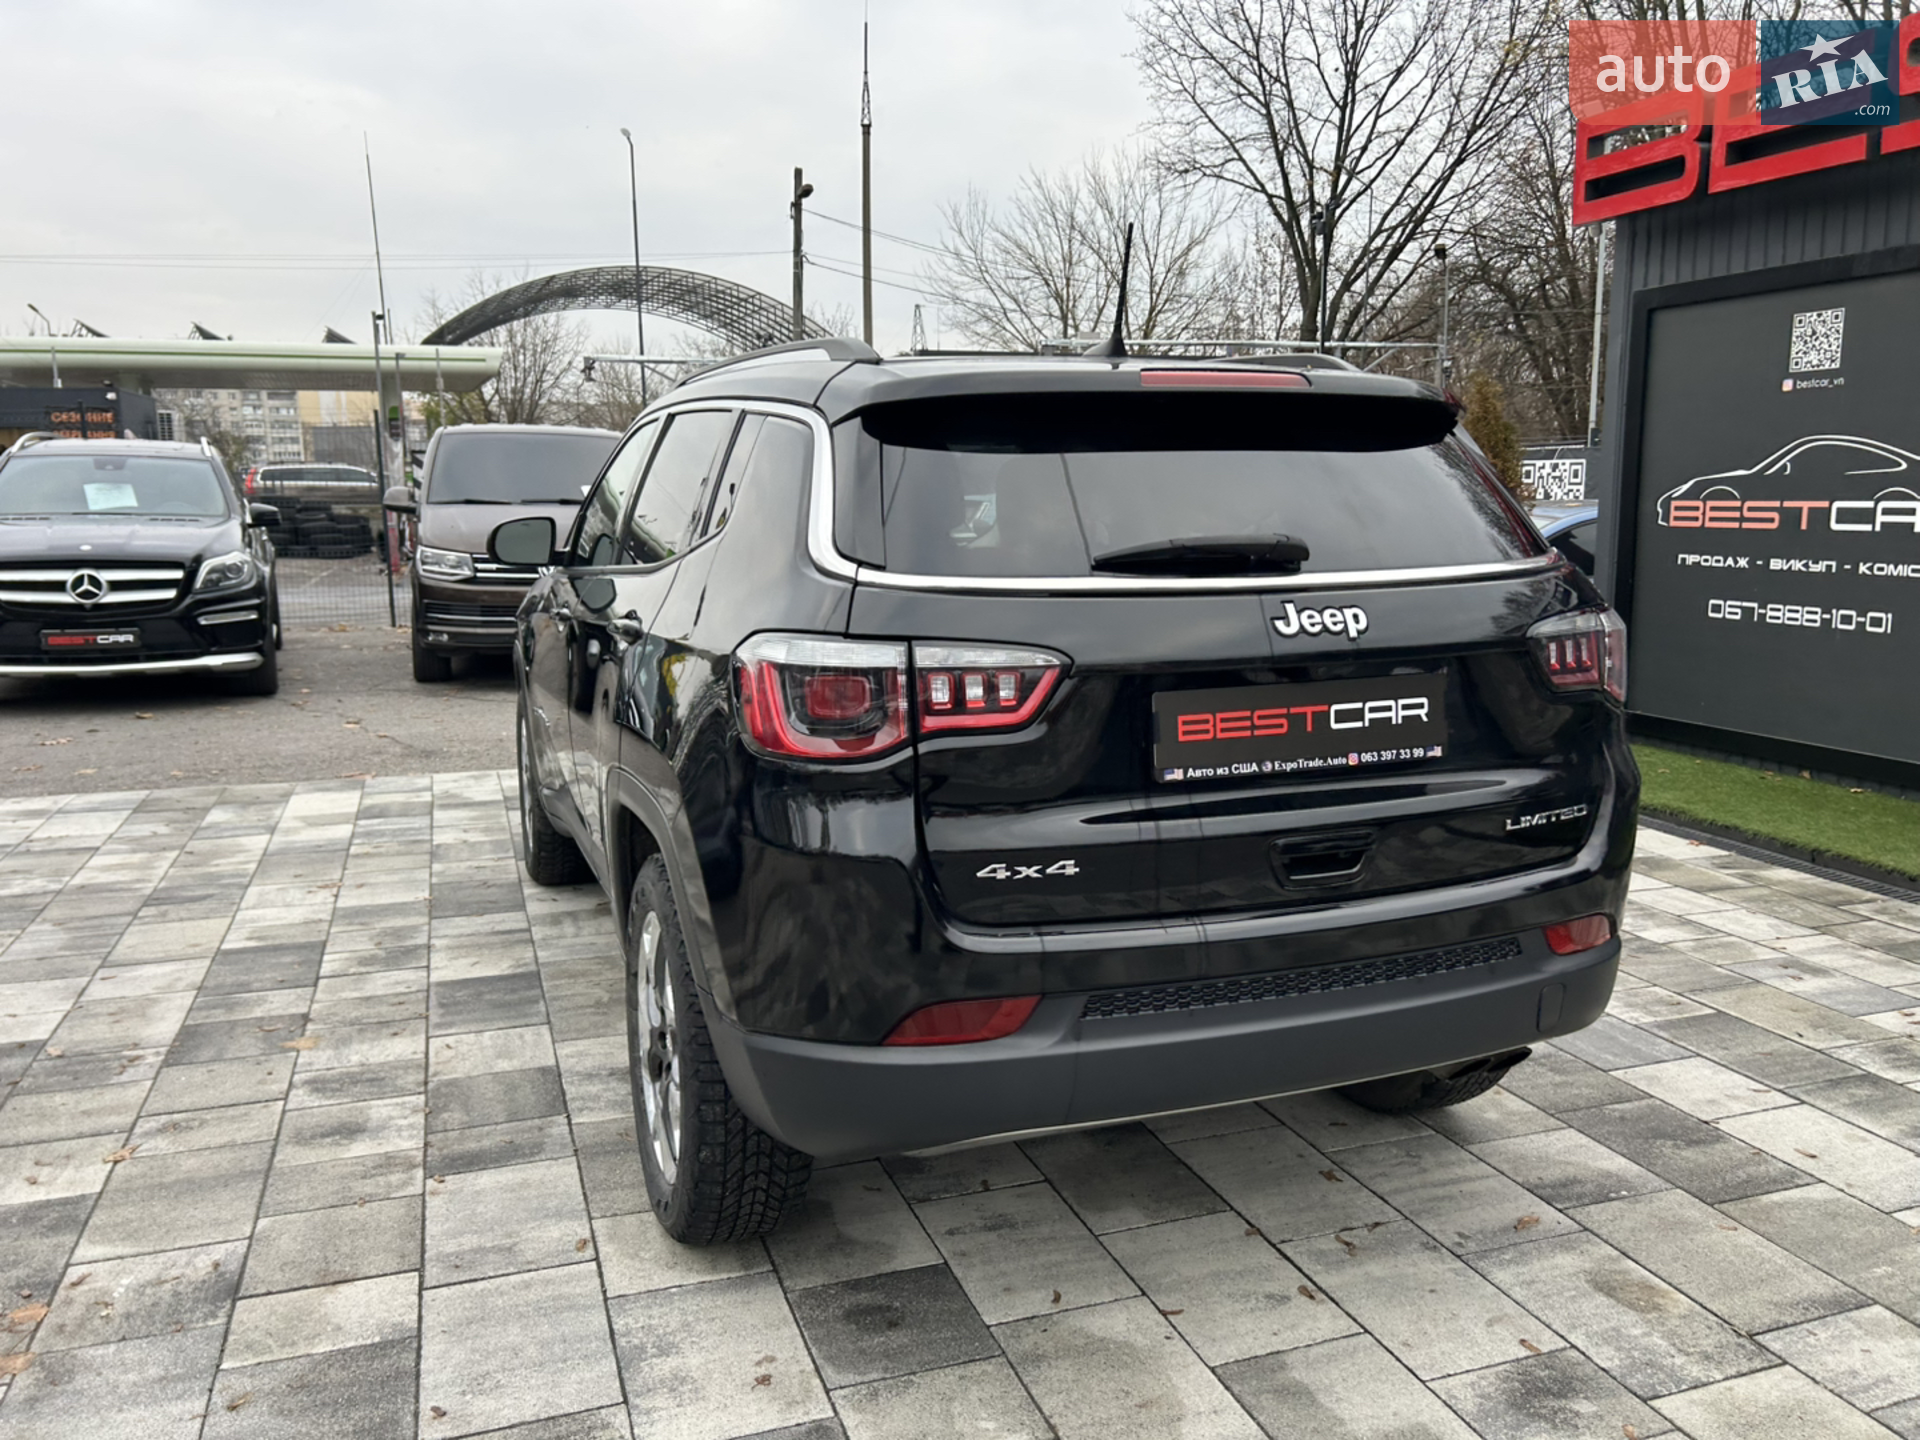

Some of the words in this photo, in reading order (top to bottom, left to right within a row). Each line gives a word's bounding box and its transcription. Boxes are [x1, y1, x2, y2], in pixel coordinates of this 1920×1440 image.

[1572, 12, 1920, 226] BE
[1796, 377, 1845, 389] bestcar_vn
[1677, 554, 1749, 569] ПРОДАЖ
[1769, 558, 1837, 573] ВИКУП
[1271, 601, 1368, 639] Jeep
[1708, 599, 1892, 634] 067-888-10-01
[47, 634, 134, 645] BESTCAR
[1177, 697, 1429, 742] BESTCAR
[1187, 767, 1214, 778] Авто
[1216, 767, 1230, 776] из
[1231, 762, 1259, 774] США
[1274, 757, 1347, 773] ExpoTrade.Auto
[1360, 752, 1378, 763] 063
[1380, 750, 1397, 761] 397
[1399, 748, 1411, 759] 33
[1413, 747, 1424, 758] 99
[1505, 804, 1588, 831] LIMITED
[976, 860, 1080, 880] 4x4
